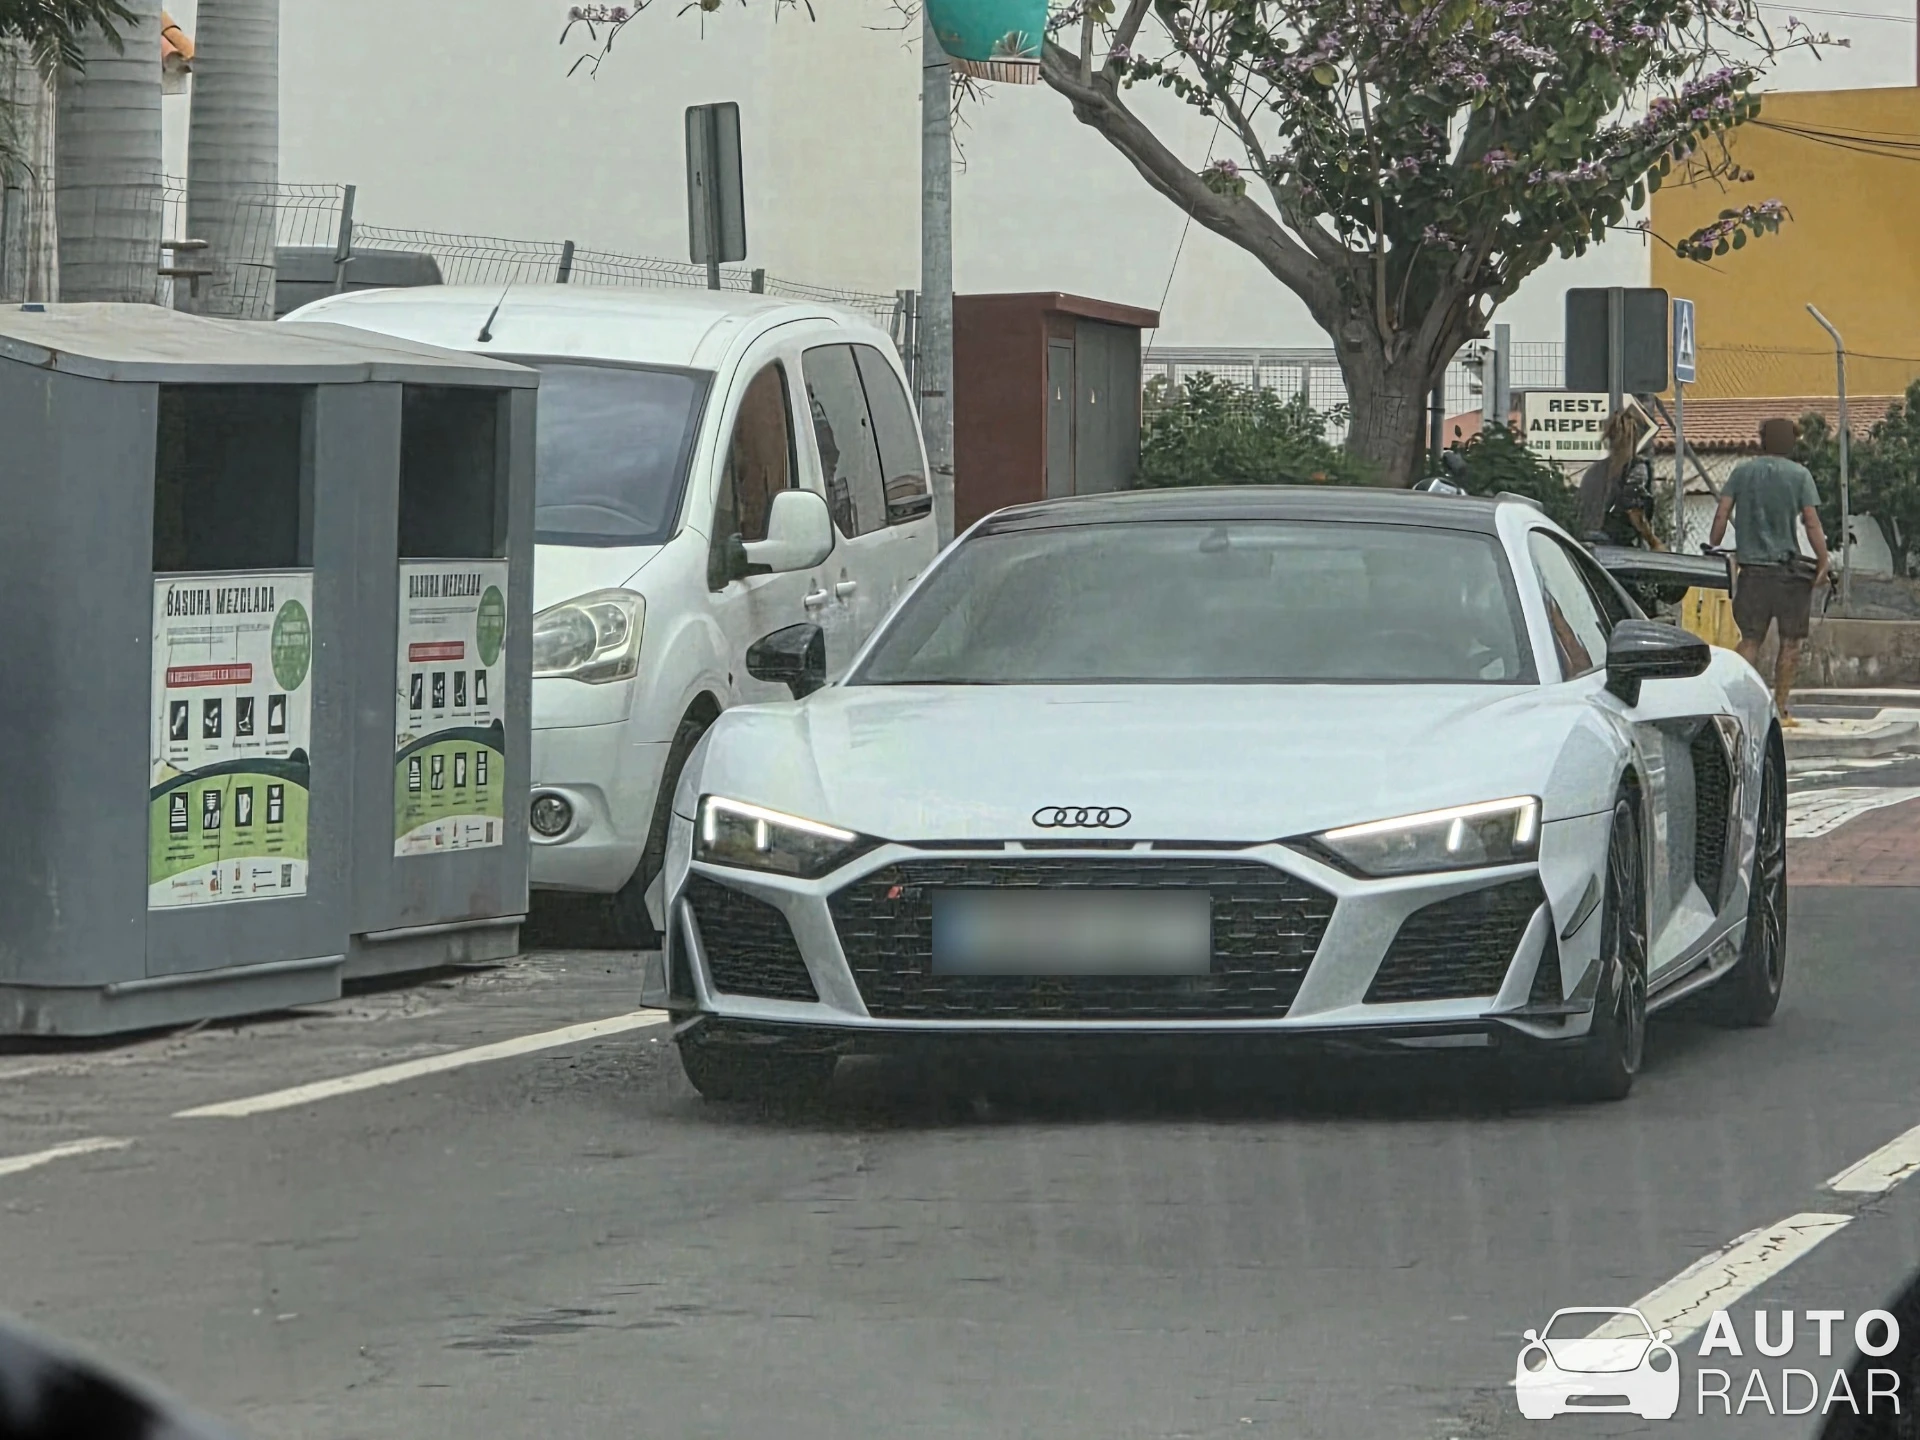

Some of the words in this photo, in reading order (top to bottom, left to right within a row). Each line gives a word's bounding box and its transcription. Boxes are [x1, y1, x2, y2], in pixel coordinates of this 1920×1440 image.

[1549, 399, 1606, 413] REST.
[167, 587, 211, 616] BASURA
[216, 586, 275, 614] MEZCLADA
